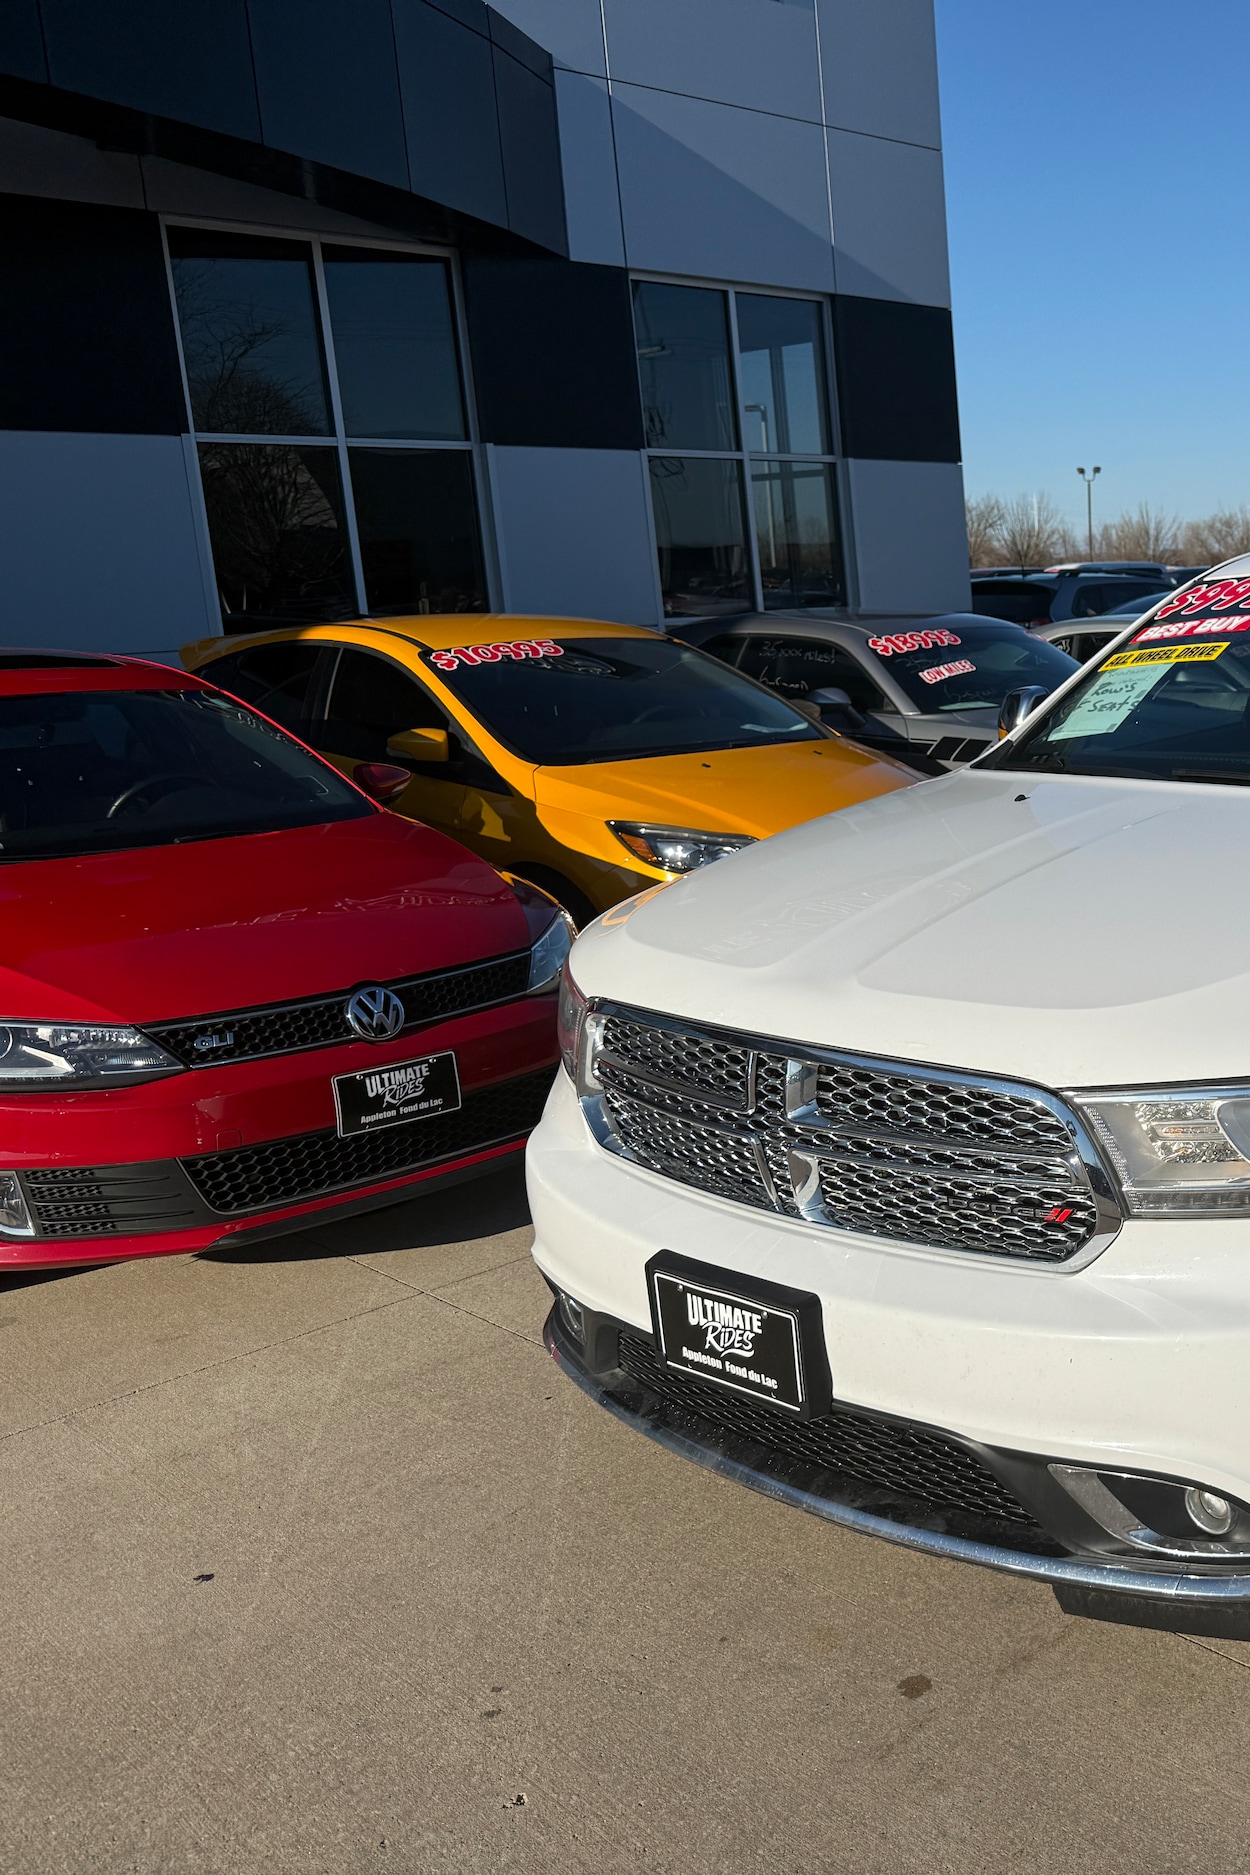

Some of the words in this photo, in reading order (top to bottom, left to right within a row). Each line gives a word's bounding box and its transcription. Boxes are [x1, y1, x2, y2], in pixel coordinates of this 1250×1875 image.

[868, 629, 962, 656] $18995
[1137, 620, 1194, 642] BEST
[430, 639, 564, 671] $10995
[1106, 653, 1135, 668] ALL
[1132, 649, 1176, 665] WHEEL
[1175, 645, 1222, 661] DRIVE
[919, 667, 944, 684] LOW
[943, 659, 976, 678] MILES
[194, 1032, 234, 1050] GLI
[365, 1063, 430, 1098] ULTIMATE
[360, 1109, 397, 1124] Appleton
[399, 1104, 418, 1115] Fond
[419, 1101, 430, 1111] du
[429, 1098, 443, 1109] Lac
[948, 1198, 1053, 1218] DODGE
[686, 1292, 763, 1335] ULTIMATE
[682, 1346, 723, 1370] Appleton
[725, 1361, 747, 1379] Fond
[748, 1369, 761, 1383] du
[761, 1373, 779, 1390] Lac
